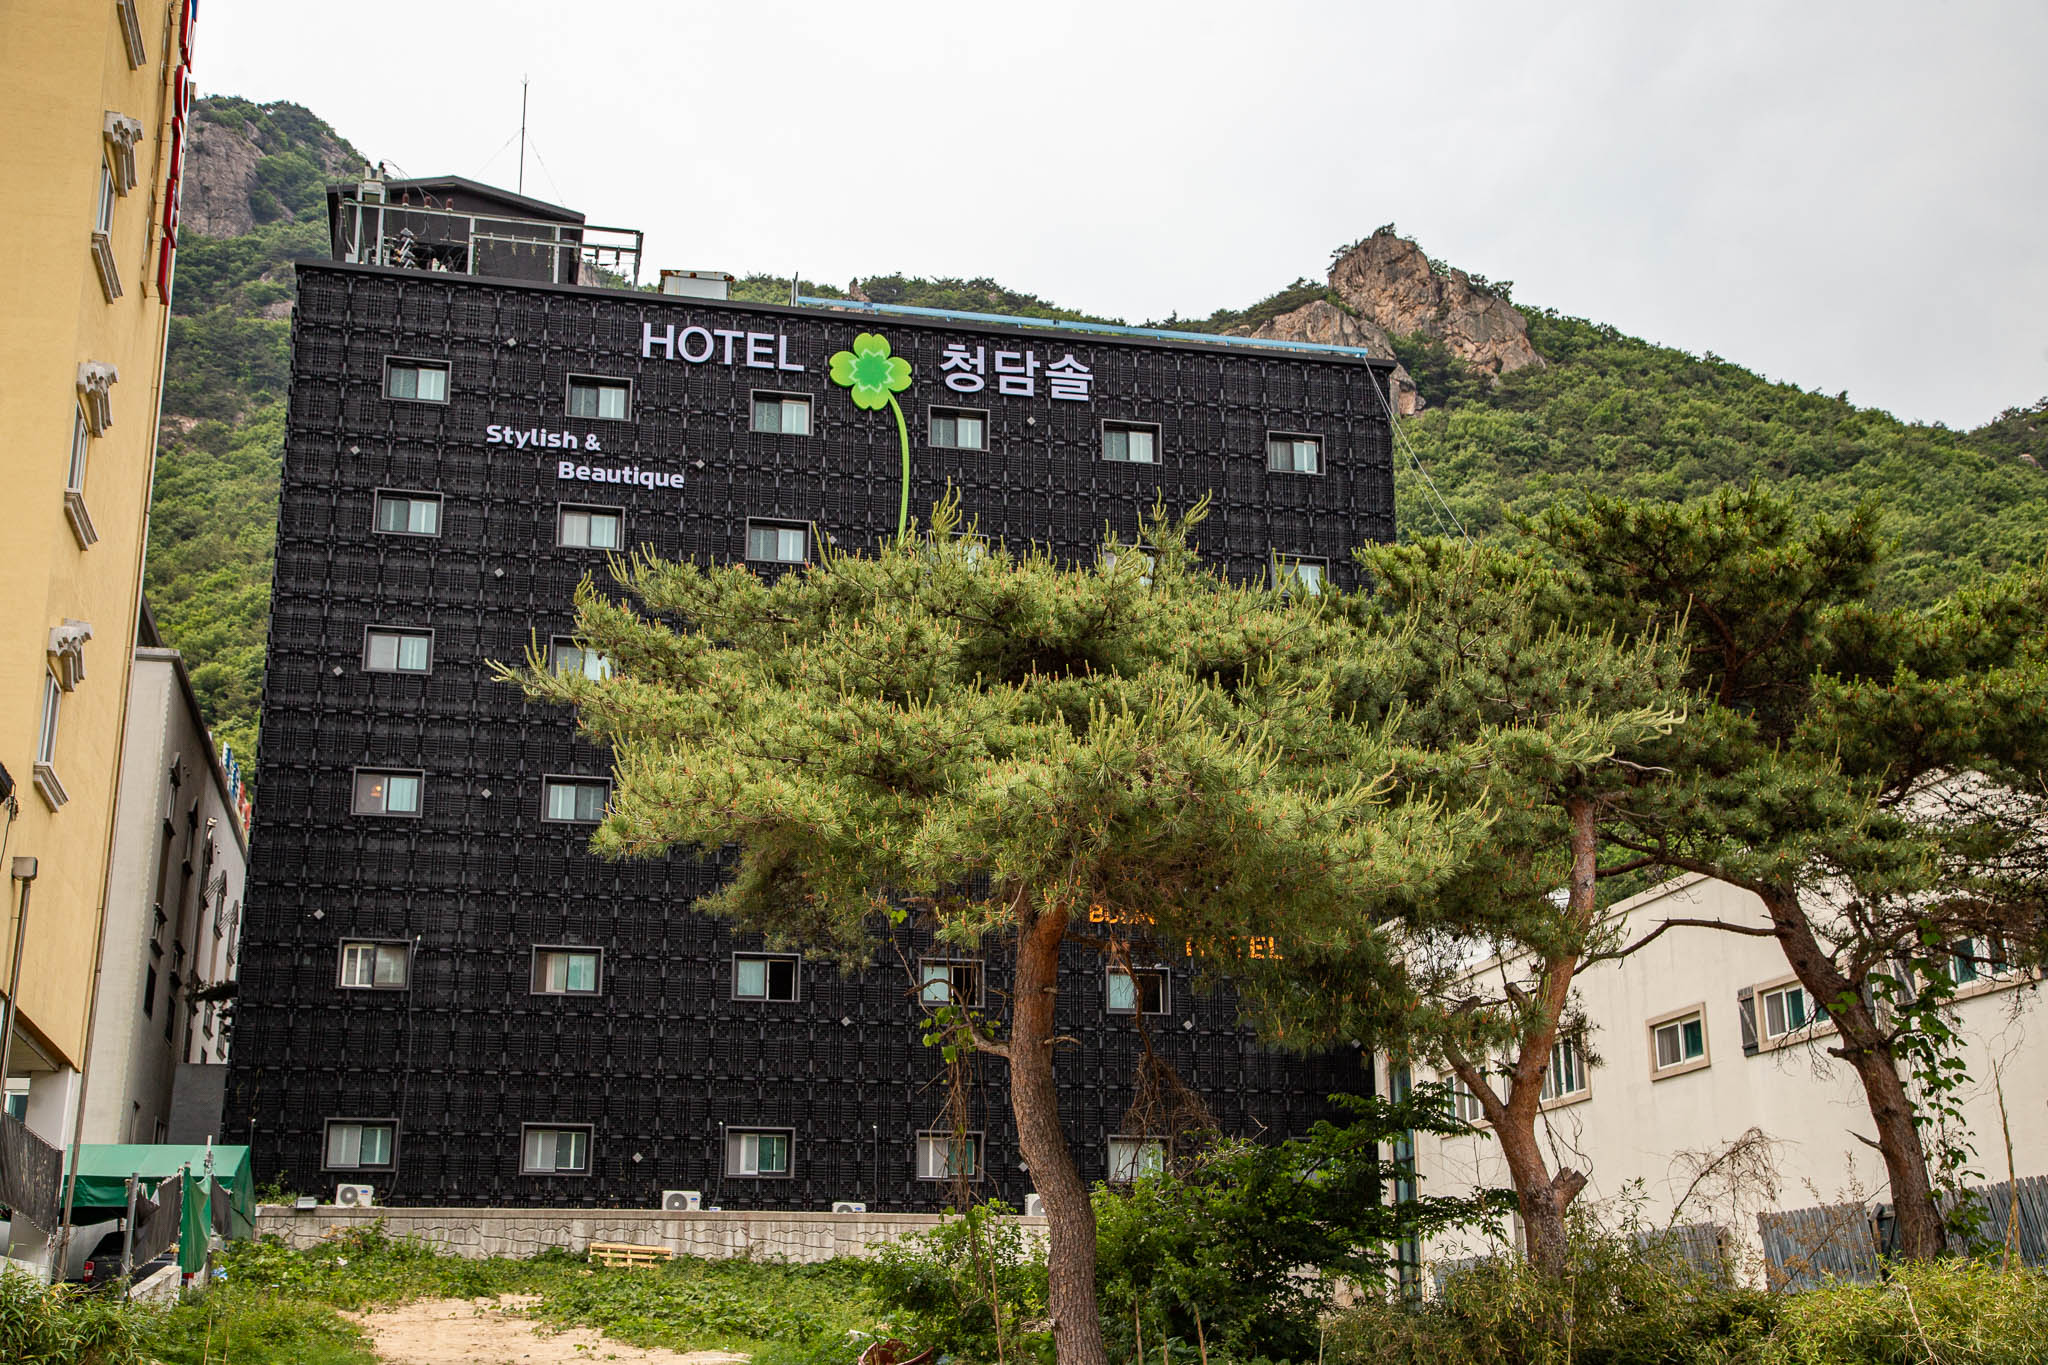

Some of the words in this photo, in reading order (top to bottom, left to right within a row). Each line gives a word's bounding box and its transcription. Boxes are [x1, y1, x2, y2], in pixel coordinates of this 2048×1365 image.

[642, 322, 805, 372] HOTEL
[939, 343, 1094, 401] 청담솔
[486, 425, 579, 449] Stylish
[584, 433, 602, 451] &
[558, 461, 685, 490] Beautique
